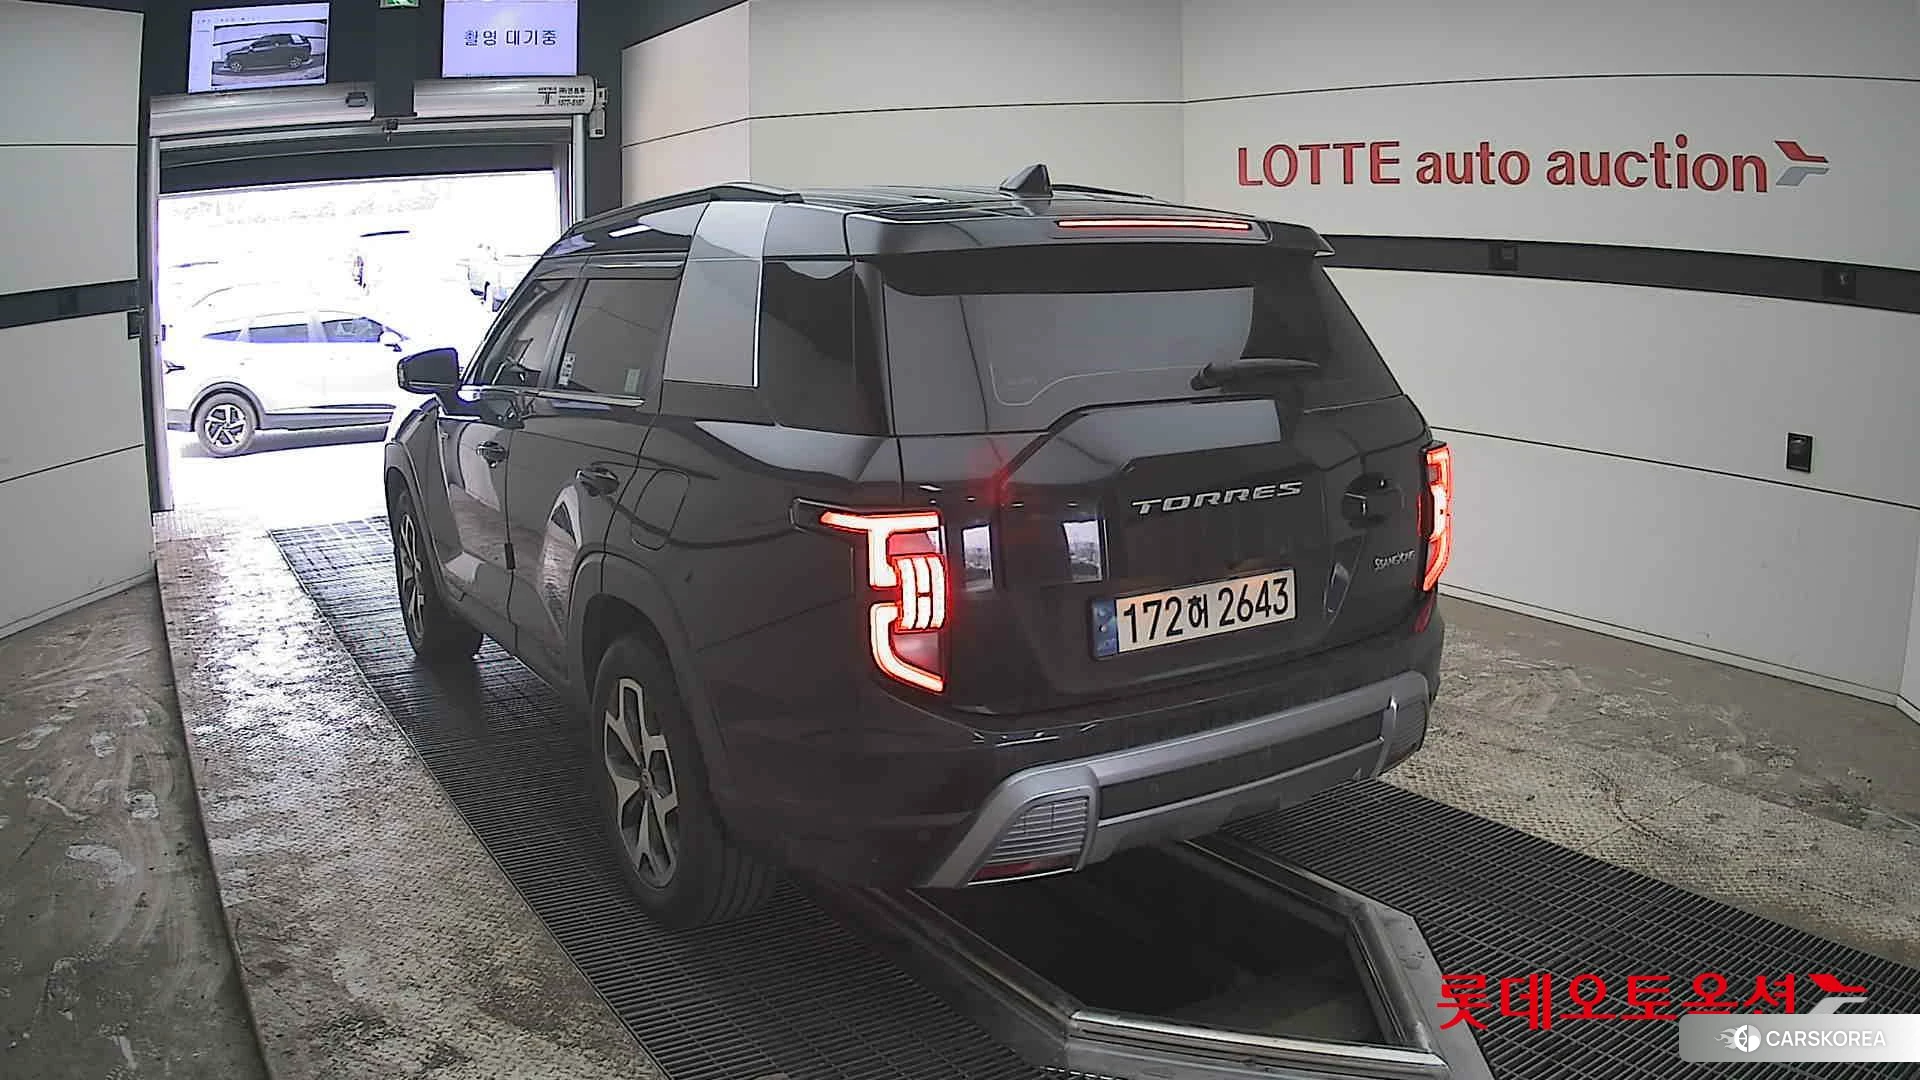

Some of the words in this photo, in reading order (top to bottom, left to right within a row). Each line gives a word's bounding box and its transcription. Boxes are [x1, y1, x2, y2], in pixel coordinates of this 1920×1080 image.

[505, 29, 557, 47] 대기중
[1238, 141, 1400, 187] LOTTE
[1416, 142, 1531, 185] auto
[1545, 134, 1768, 193] auction
[1131, 481, 1303, 514] TORRES
[1123, 593, 1209, 643] 172허
[1217, 576, 1289, 627] 2643
